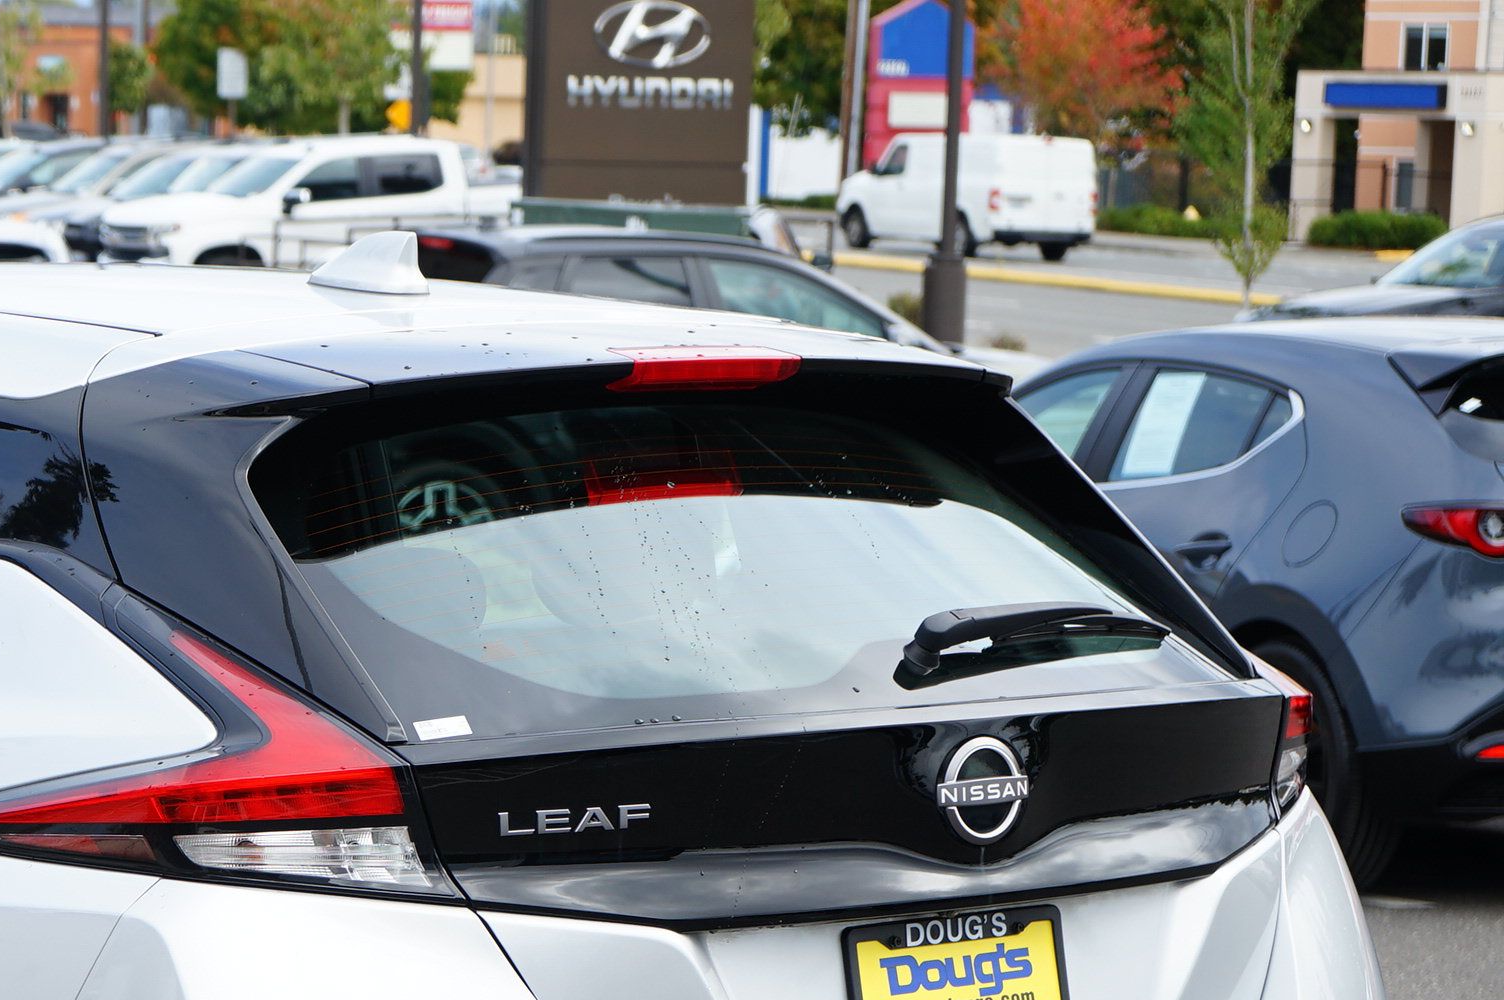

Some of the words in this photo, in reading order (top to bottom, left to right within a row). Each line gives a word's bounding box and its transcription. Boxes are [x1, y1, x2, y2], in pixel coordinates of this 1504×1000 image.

[567, 74, 734, 110] HYUNDAI
[941, 780, 1028, 804] NISSAN
[498, 803, 652, 837] LEAF
[905, 912, 1008, 948] DOUG'S
